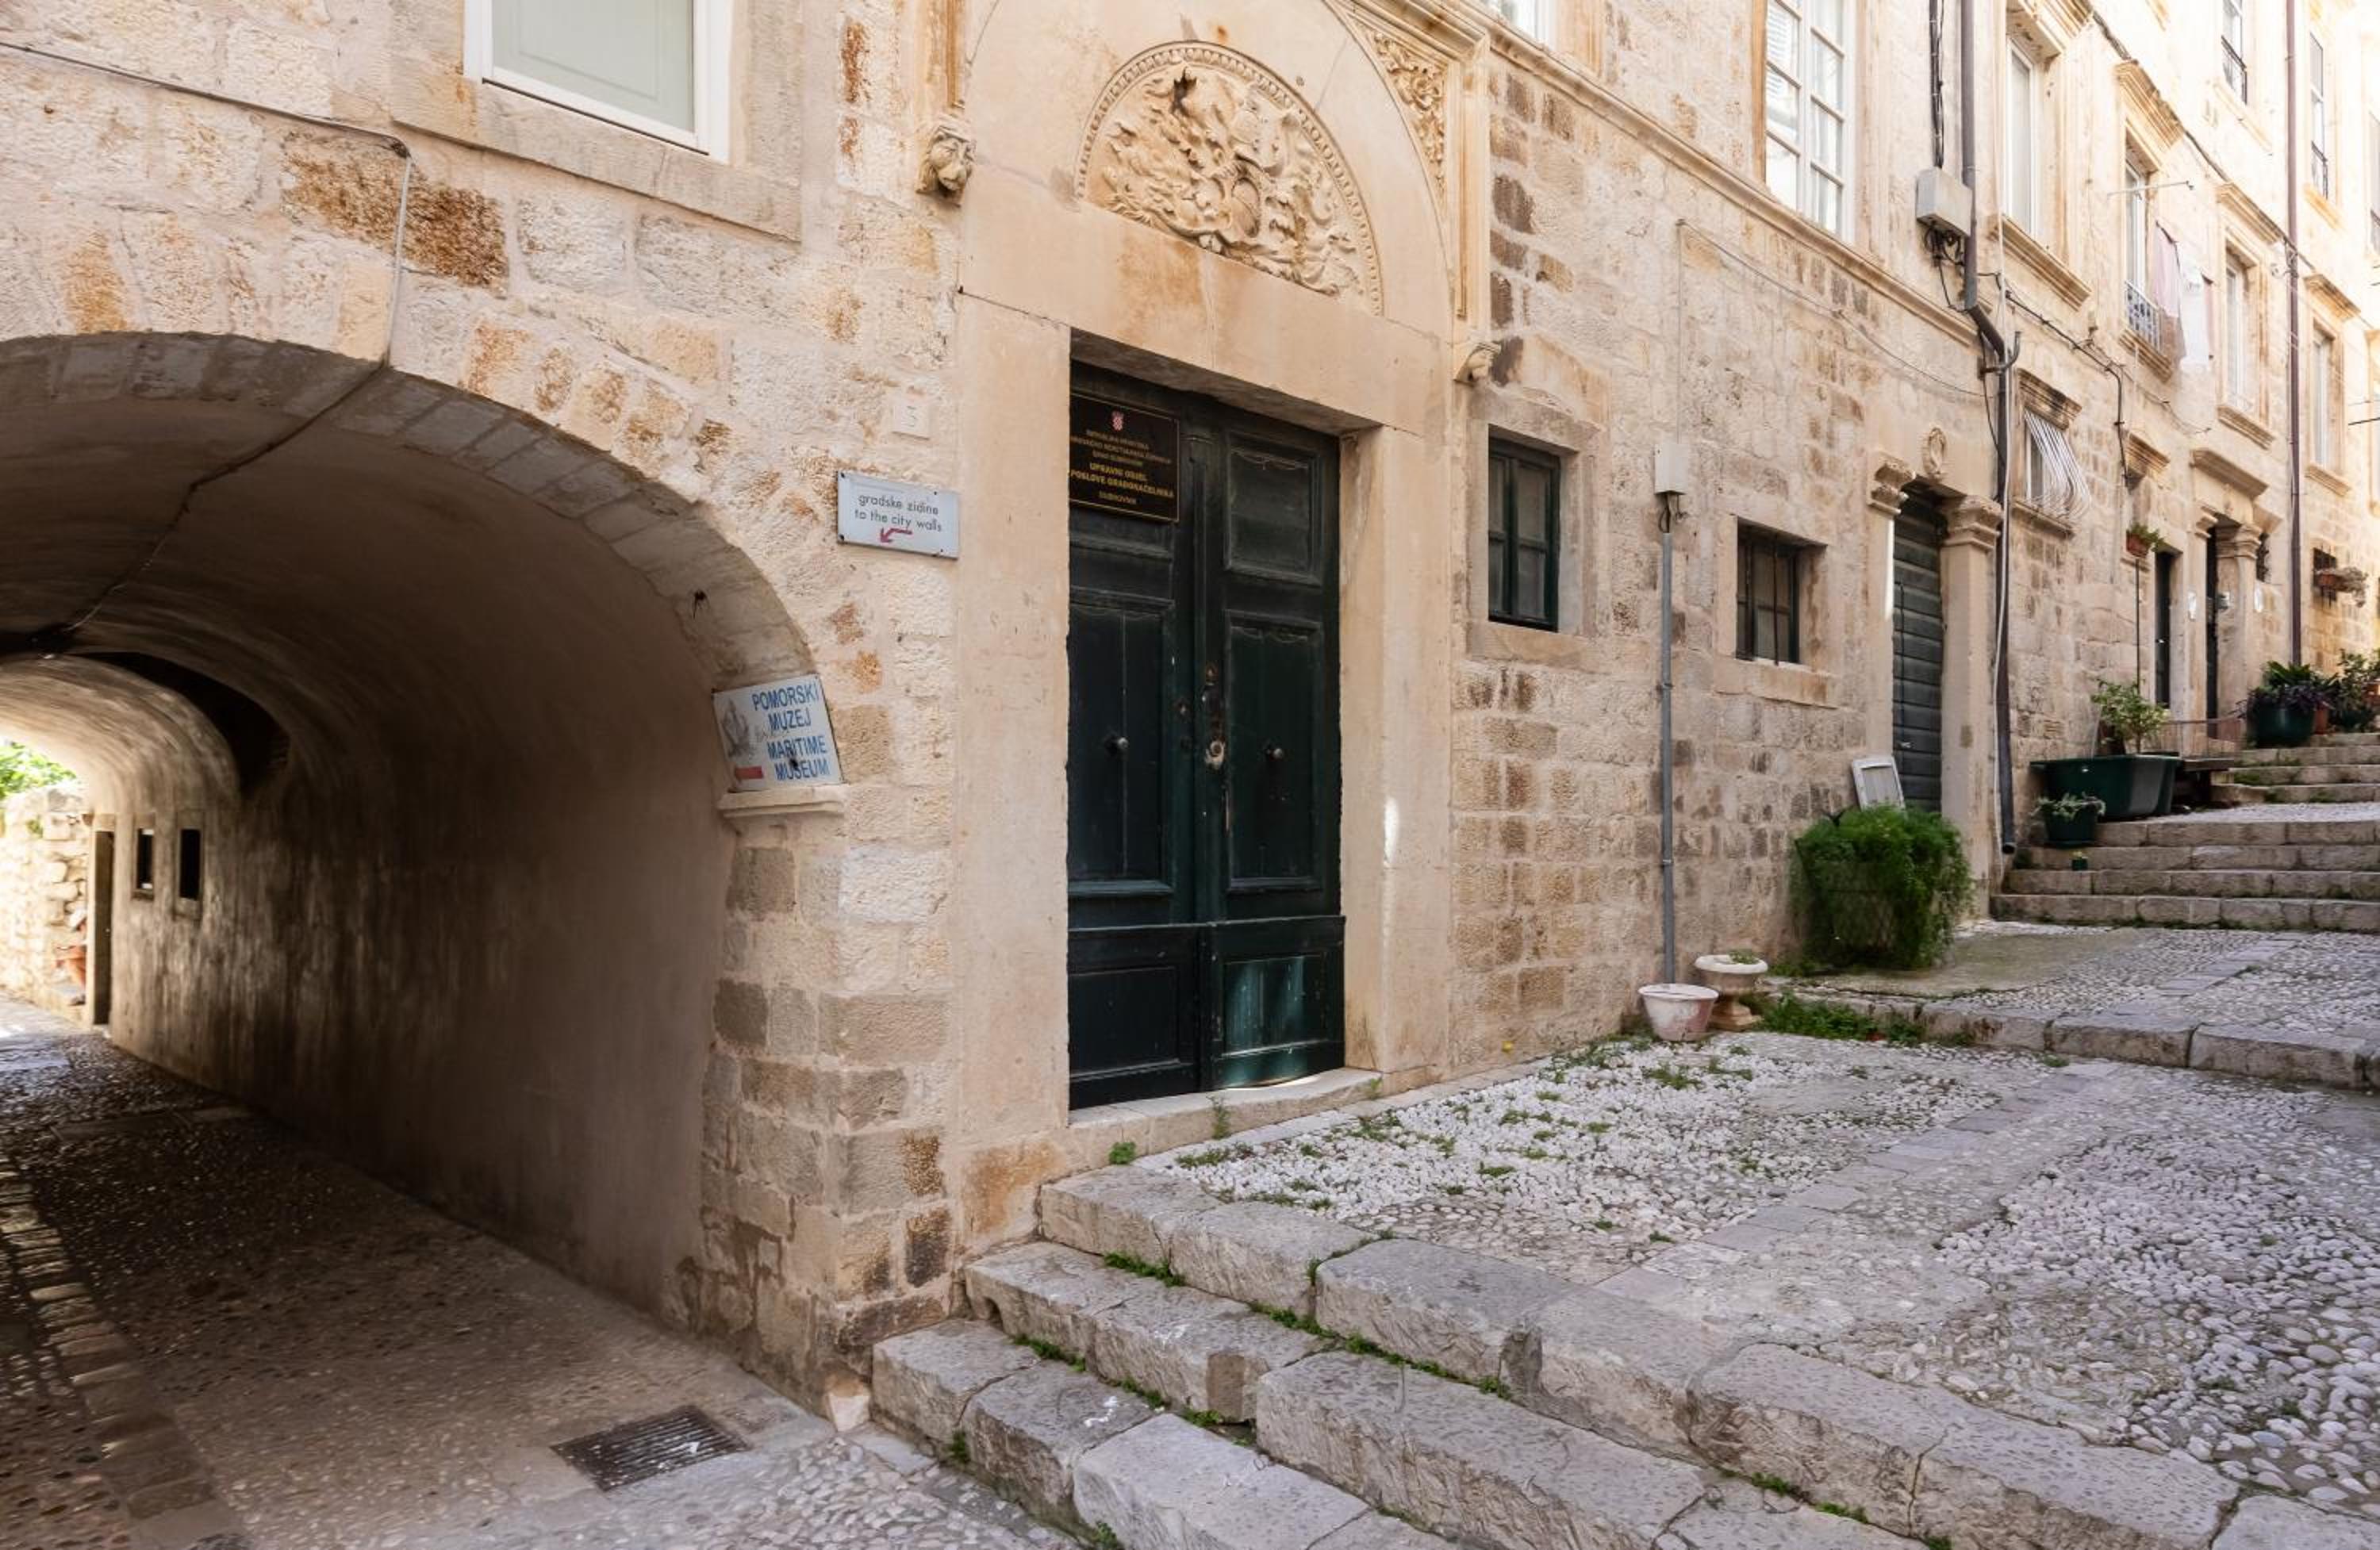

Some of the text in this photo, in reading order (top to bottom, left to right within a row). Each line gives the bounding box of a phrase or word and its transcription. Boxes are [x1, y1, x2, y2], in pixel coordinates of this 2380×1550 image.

[858, 494, 939, 516] gradske zidine
[854, 509, 942, 532] to the city walls
[752, 683, 820, 711] POMORSKI
[768, 708, 812, 731] MUZEJ
[767, 735, 828, 759] MARITIME
[774, 758, 831, 781] MUSEUM
